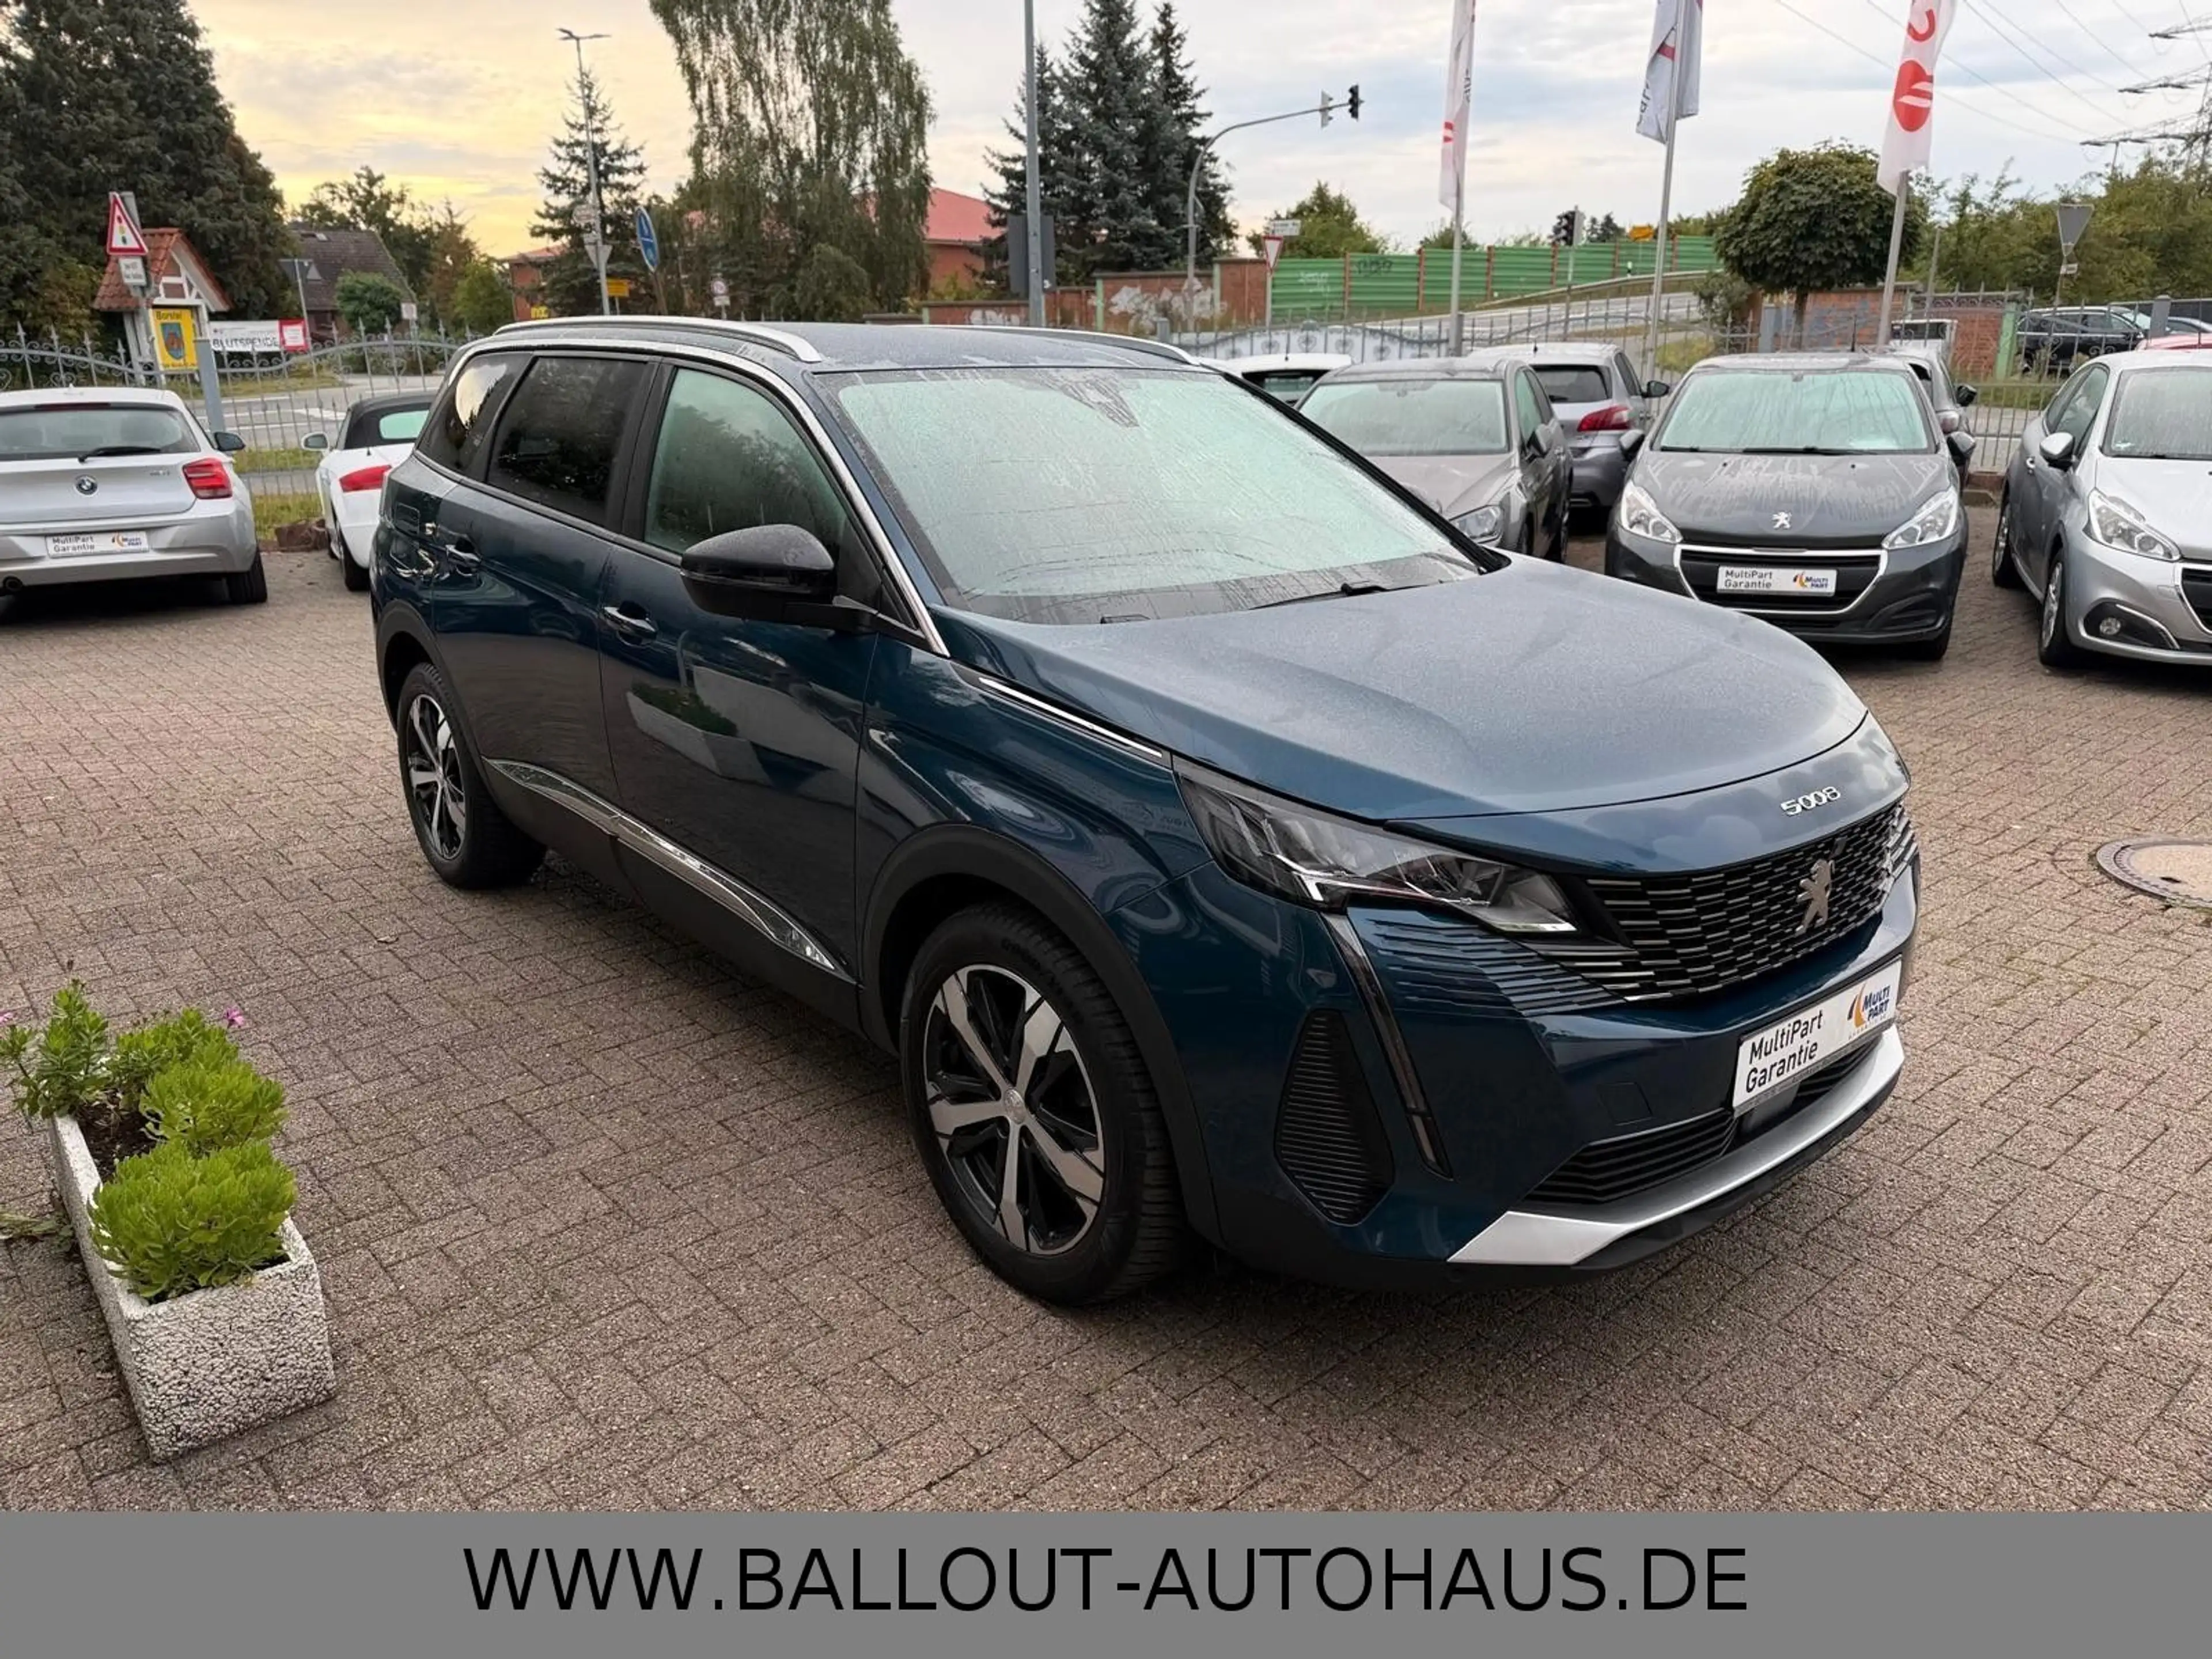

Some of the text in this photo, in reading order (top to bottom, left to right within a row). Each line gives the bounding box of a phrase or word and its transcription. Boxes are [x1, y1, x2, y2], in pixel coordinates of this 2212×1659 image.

[52, 536, 93, 544] MultiPart
[54, 544, 95, 552] Garantie
[1725, 569, 1772, 579] MultiPart
[1724, 579, 1772, 589] Garantie
[1781, 786, 1841, 815] 5008
[1868, 999, 1889, 1021] PART
[1749, 1010, 1823, 1065] MultiPart
[1745, 1040, 1818, 1093] Garantie
